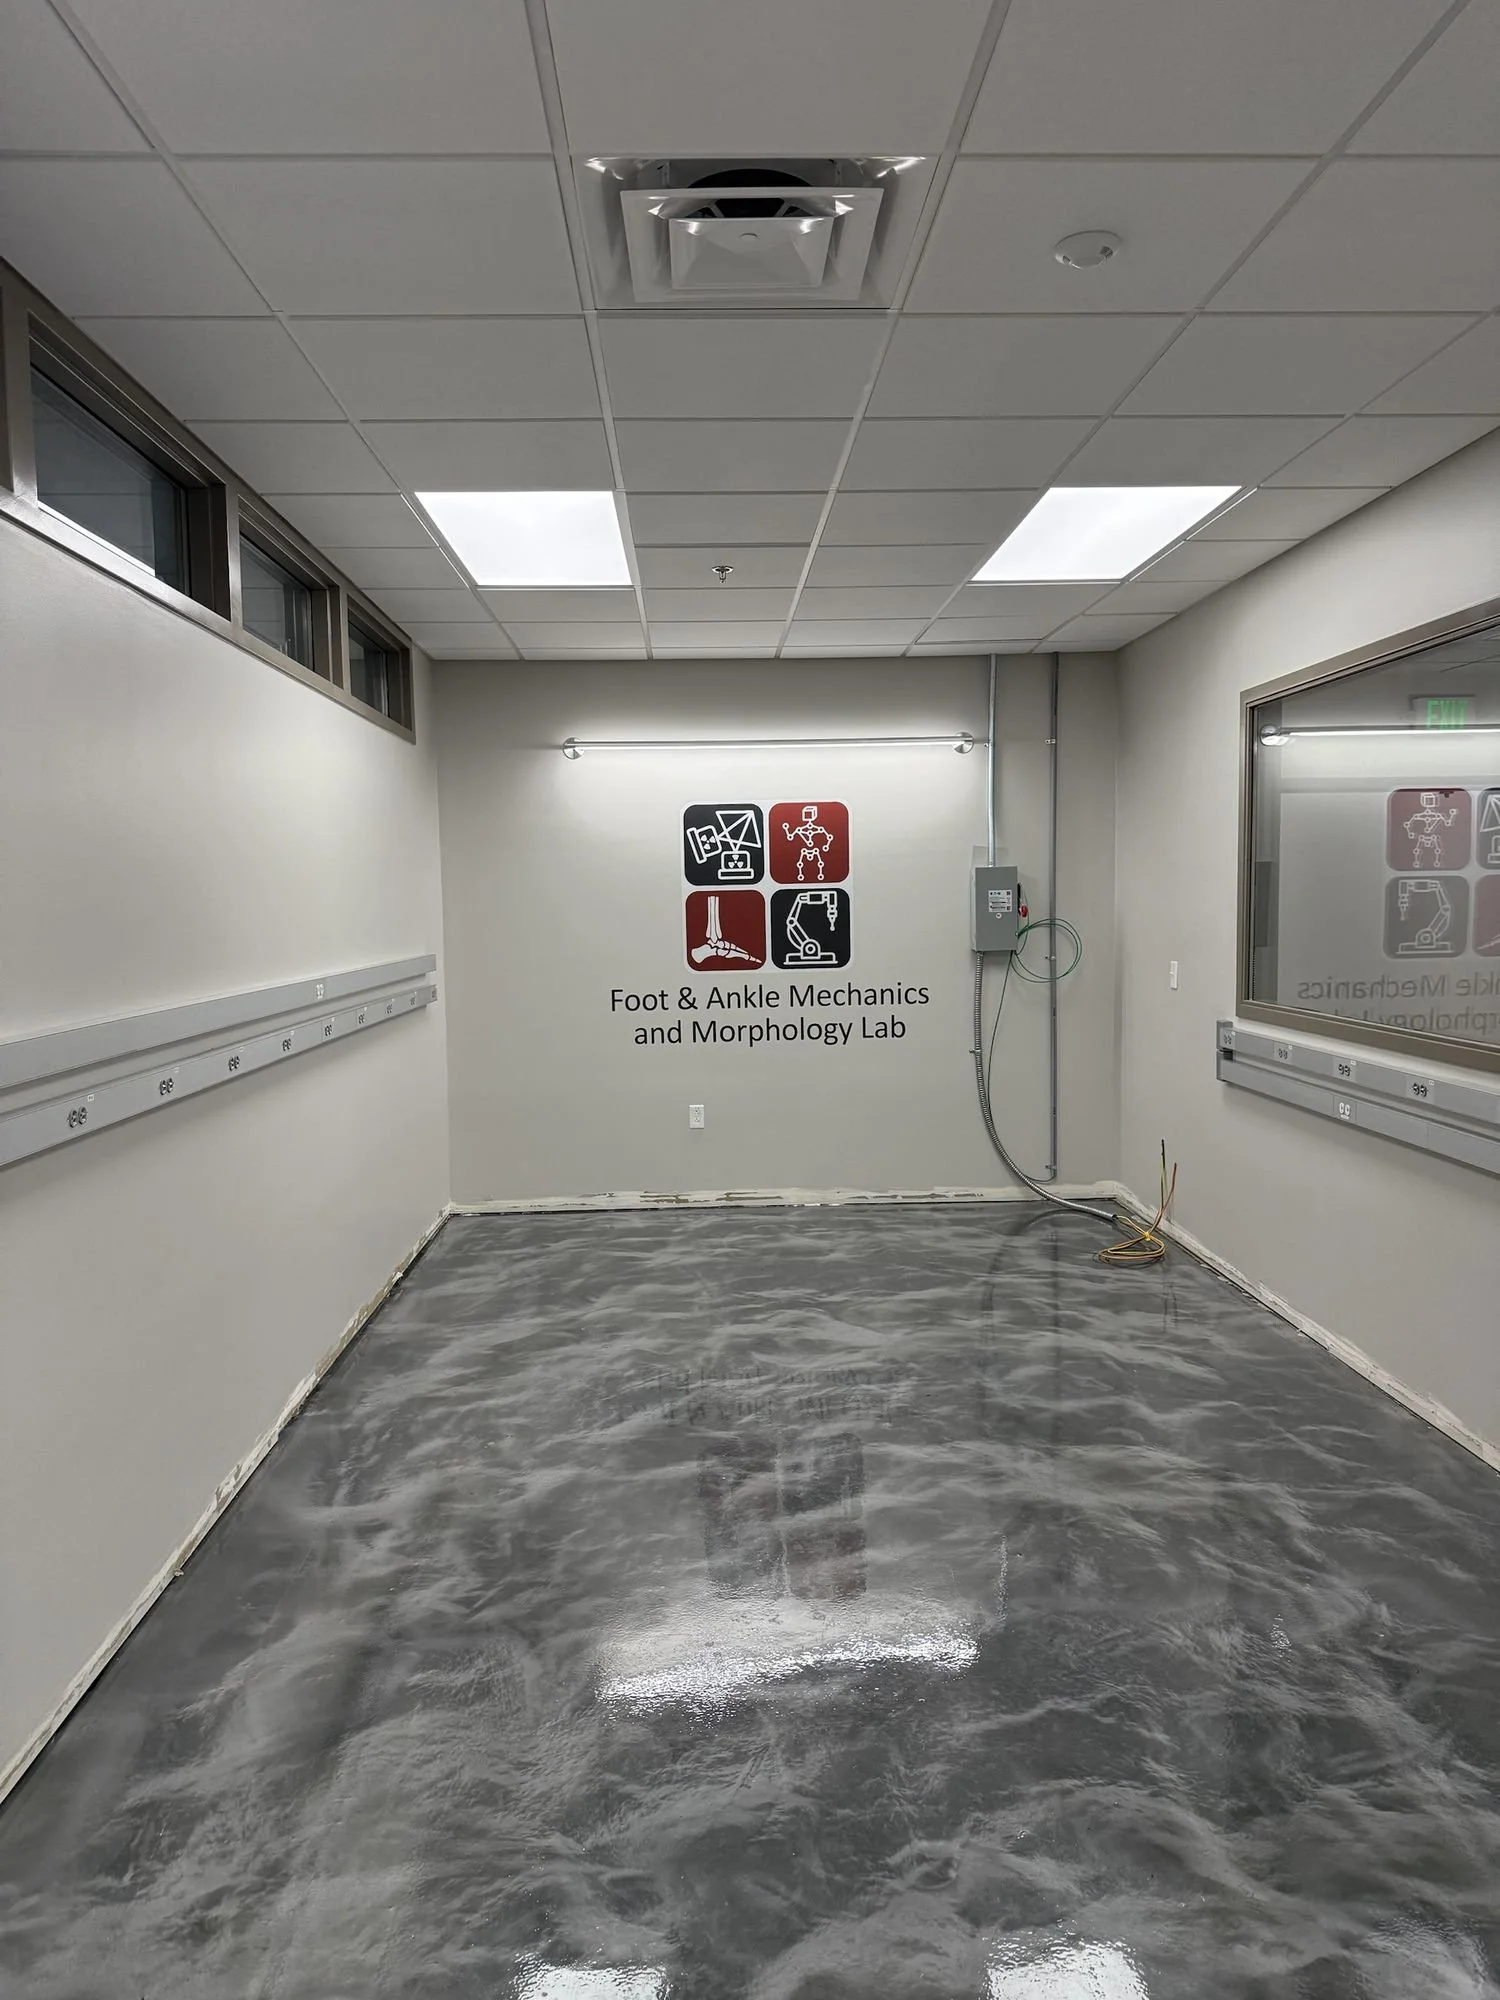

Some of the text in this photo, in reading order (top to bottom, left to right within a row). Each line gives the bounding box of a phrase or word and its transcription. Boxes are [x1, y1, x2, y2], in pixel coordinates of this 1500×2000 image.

[611, 981, 930, 1012] Foot & Ankle Mechanics
[634, 1014, 907, 1048] and Morphology Lab
